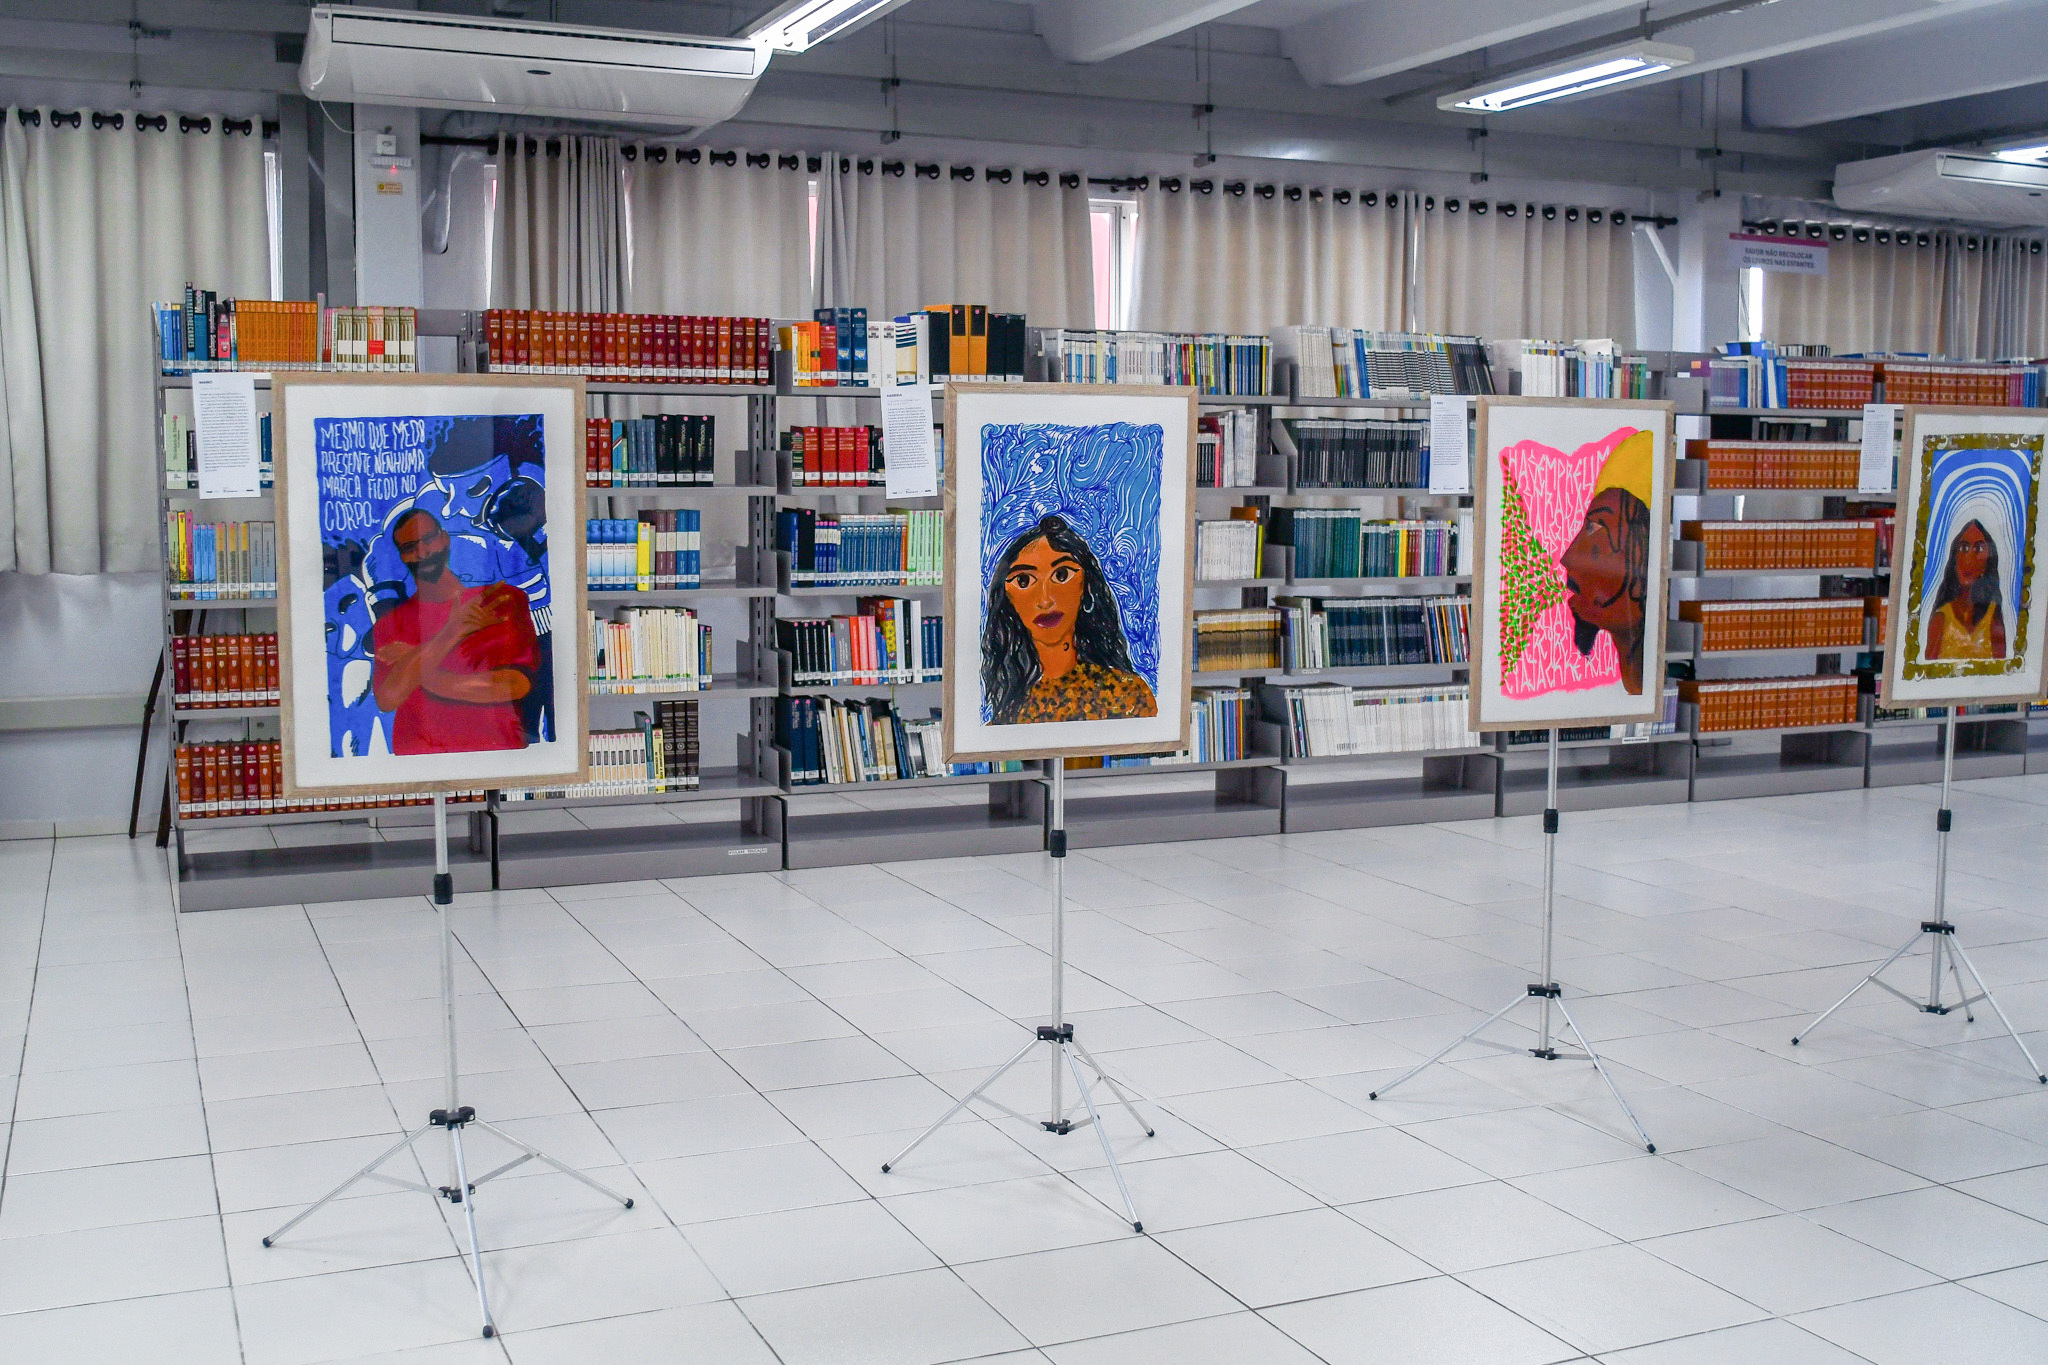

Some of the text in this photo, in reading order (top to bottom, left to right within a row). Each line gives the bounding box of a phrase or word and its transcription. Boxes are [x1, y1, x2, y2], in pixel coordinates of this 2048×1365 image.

[1752, 257, 1774, 266] LIVROS
[1765, 248, 1779, 257] NÃO
[1779, 250, 1813, 259] RECOLOCAR
[321, 419, 425, 452] MESMO QUE MEDO
[375, 448, 425, 475] NENHUMA
[323, 475, 417, 501] MARCA FICOU NO
